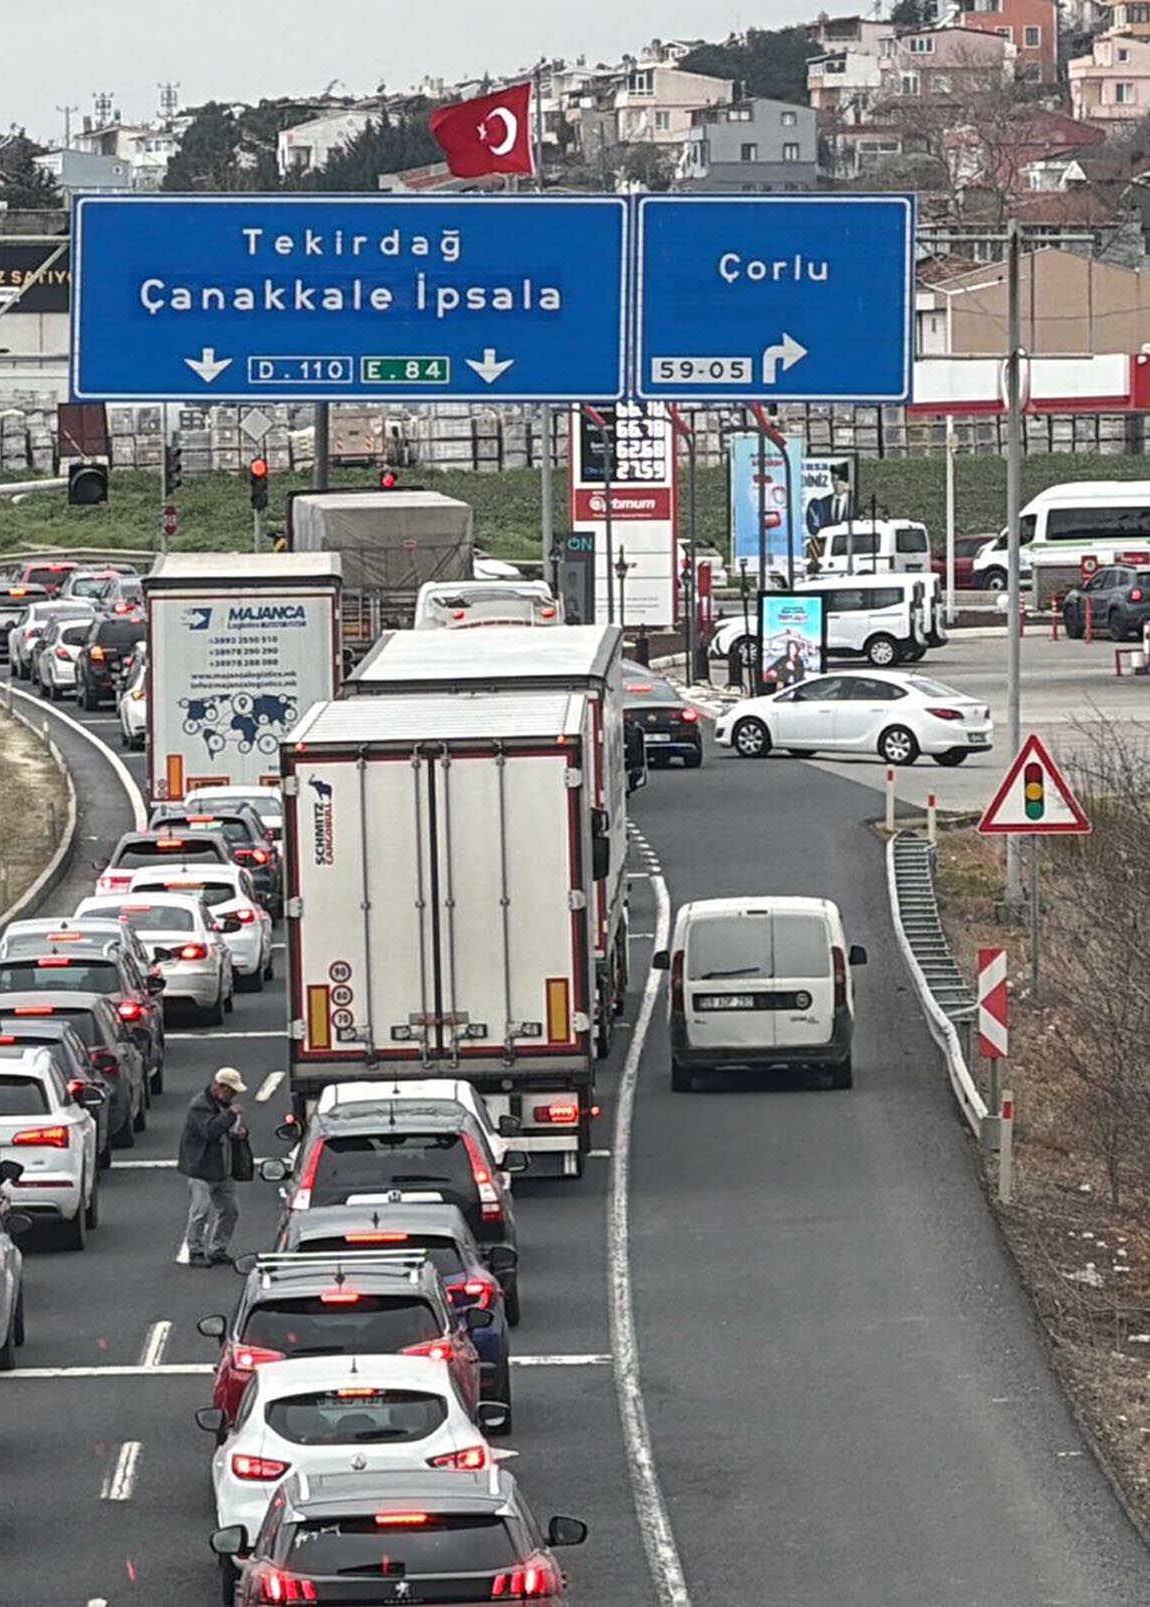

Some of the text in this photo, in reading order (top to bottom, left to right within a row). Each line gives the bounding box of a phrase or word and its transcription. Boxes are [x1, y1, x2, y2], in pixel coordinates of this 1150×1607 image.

[242, 229, 461, 262] Tekirdağ
[719, 253, 829, 283] Çorlu
[140, 272, 561, 318] Çanakkale İpsala
[660, 360, 745, 379] 59-05
[228, 606, 306, 621] MAJANCA
[314, 802, 325, 866] SCHMITZ
